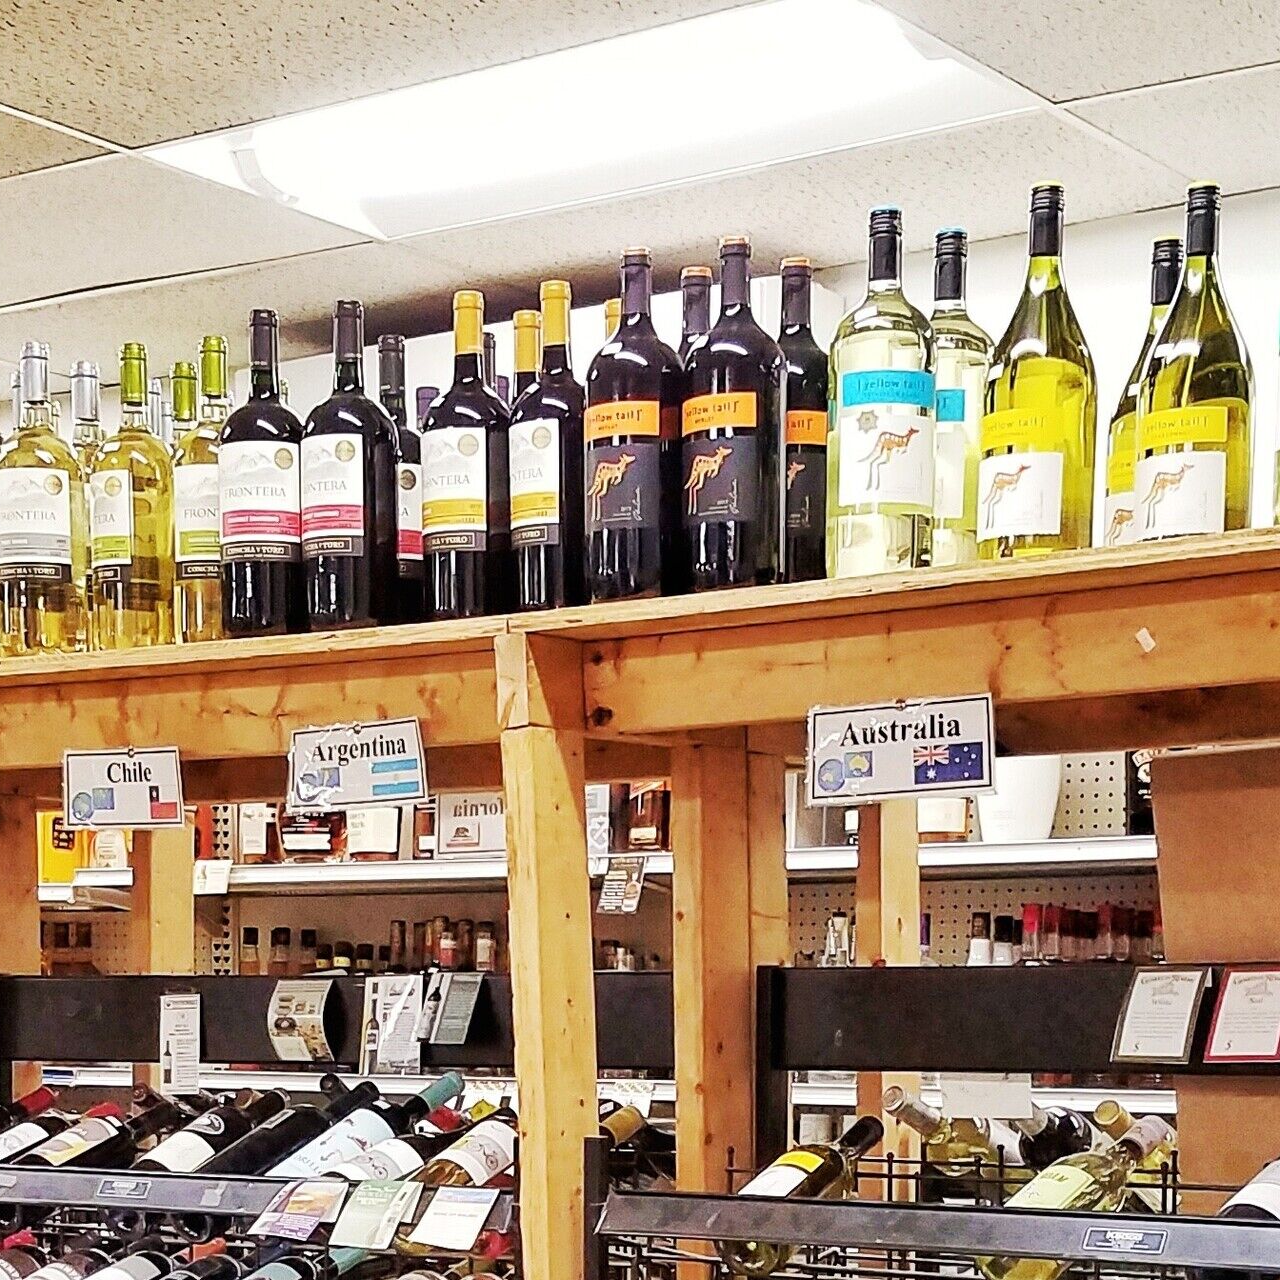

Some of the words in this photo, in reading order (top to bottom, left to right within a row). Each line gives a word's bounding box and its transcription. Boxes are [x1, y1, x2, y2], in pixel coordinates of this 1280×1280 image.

[839, 712, 962, 748] Australia
[312, 734, 406, 768] Argentina
[106, 760, 152, 785] Chile
